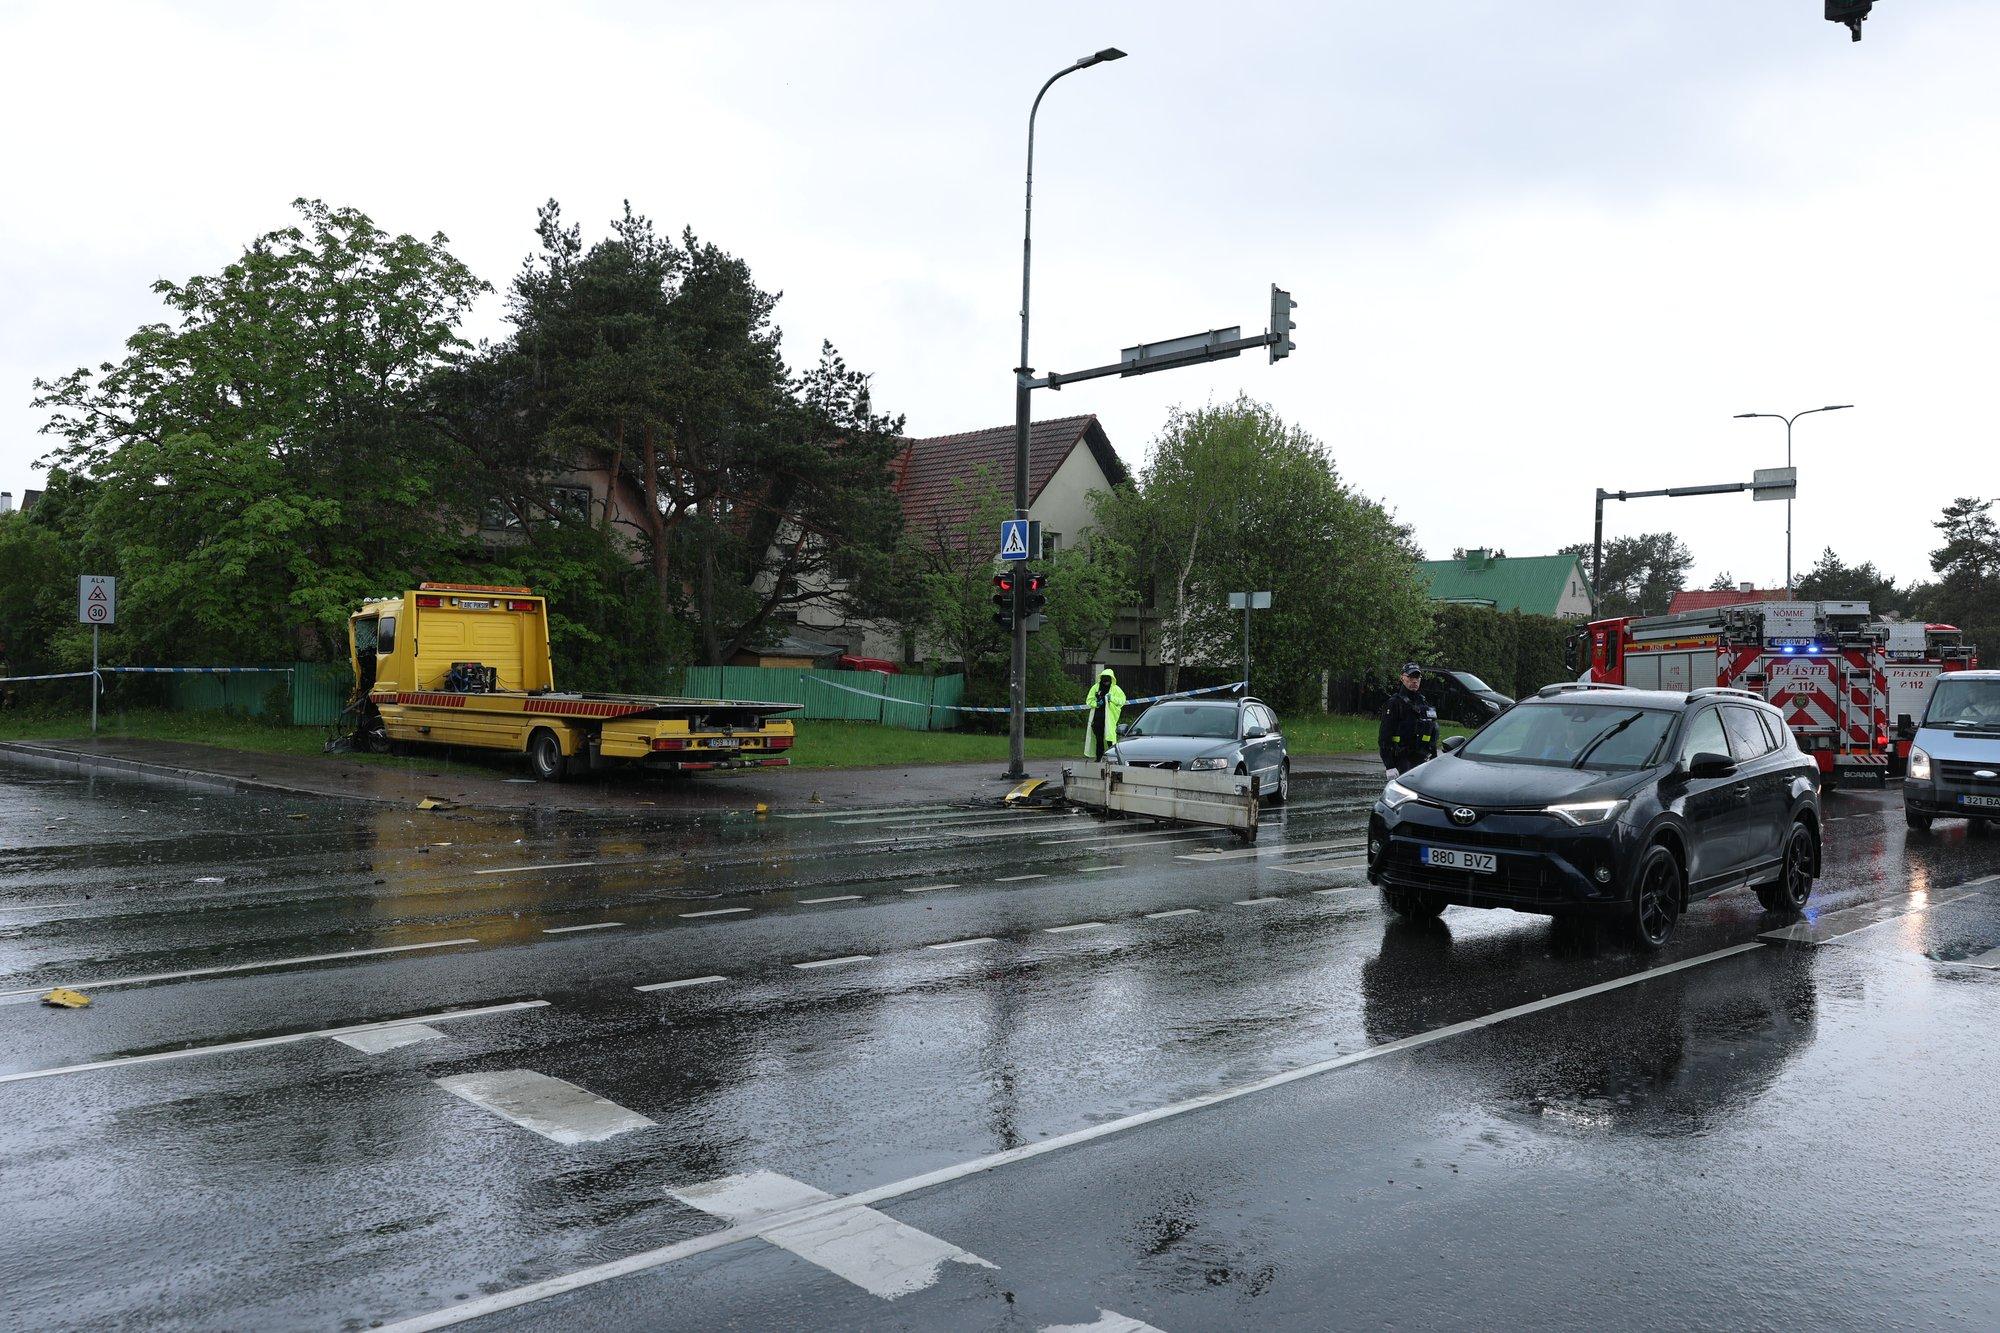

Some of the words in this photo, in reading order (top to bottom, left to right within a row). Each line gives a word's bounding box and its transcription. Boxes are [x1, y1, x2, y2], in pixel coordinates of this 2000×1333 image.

[92, 609, 103, 617] 30
[1775, 664, 1827, 676] PÄÄSTE
[1892, 669, 1933, 678] PÄÄSTE
[1798, 681, 1815, 691] 112
[1909, 681, 1924, 689] 112
[1966, 796, 1983, 805] 321
[1432, 850, 1454, 864] 880
[1464, 853, 1493, 869] BVZ
